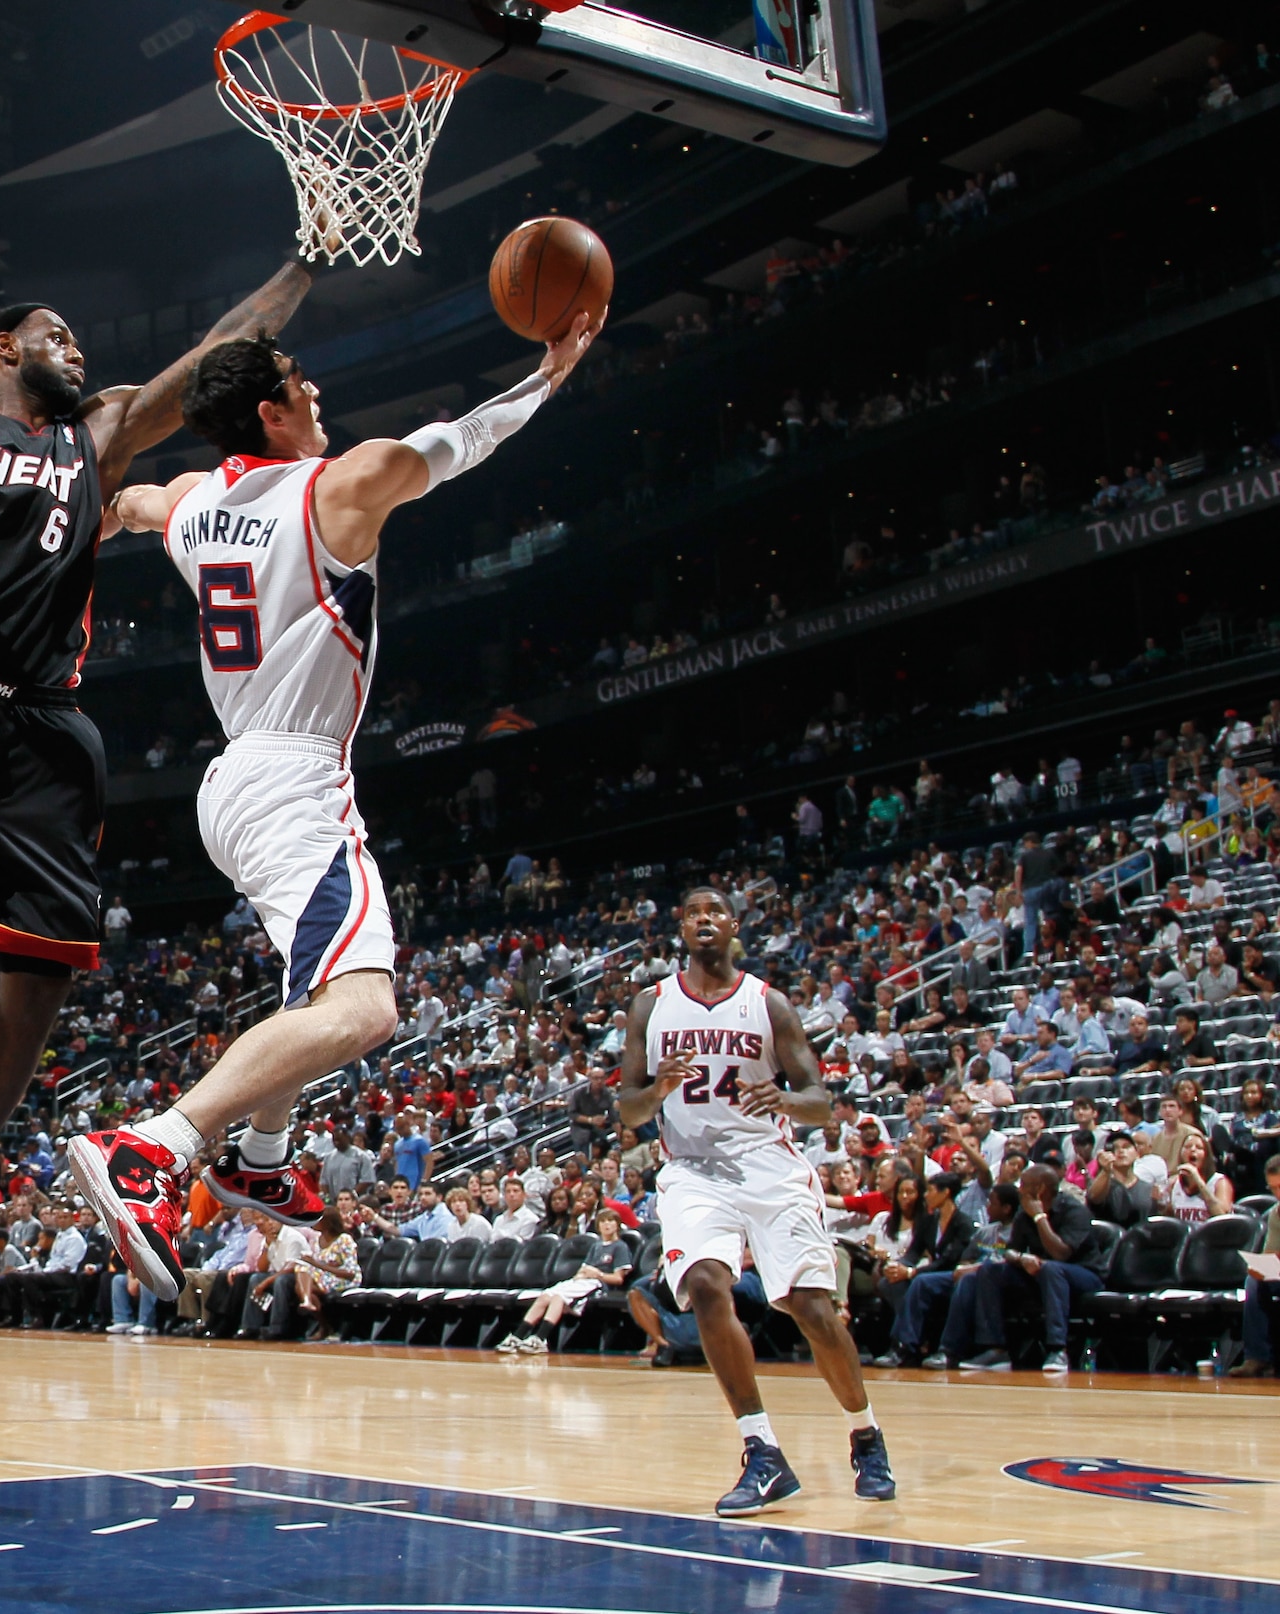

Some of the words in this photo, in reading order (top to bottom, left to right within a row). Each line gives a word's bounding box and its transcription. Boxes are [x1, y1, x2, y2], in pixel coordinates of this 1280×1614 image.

[39, 505, 70, 553] 6
[181, 509, 278, 554] HINRICH
[1085, 500, 1190, 552] TWICE
[198, 561, 263, 672] 6
[597, 645, 724, 703] GENTLEMAN
[731, 629, 785, 668] JACK
[796, 613, 837, 639] RARE
[843, 582, 938, 625] TENNESSEE
[944, 554, 1030, 592] WHISKEY
[395, 722, 466, 750] GENTLEMAN
[418, 738, 444, 756] JACK
[1054, 781, 1078, 798] 103
[633, 865, 652, 879] 102
[661, 1029, 763, 1061] HAWKS
[683, 1065, 741, 1106] 24
